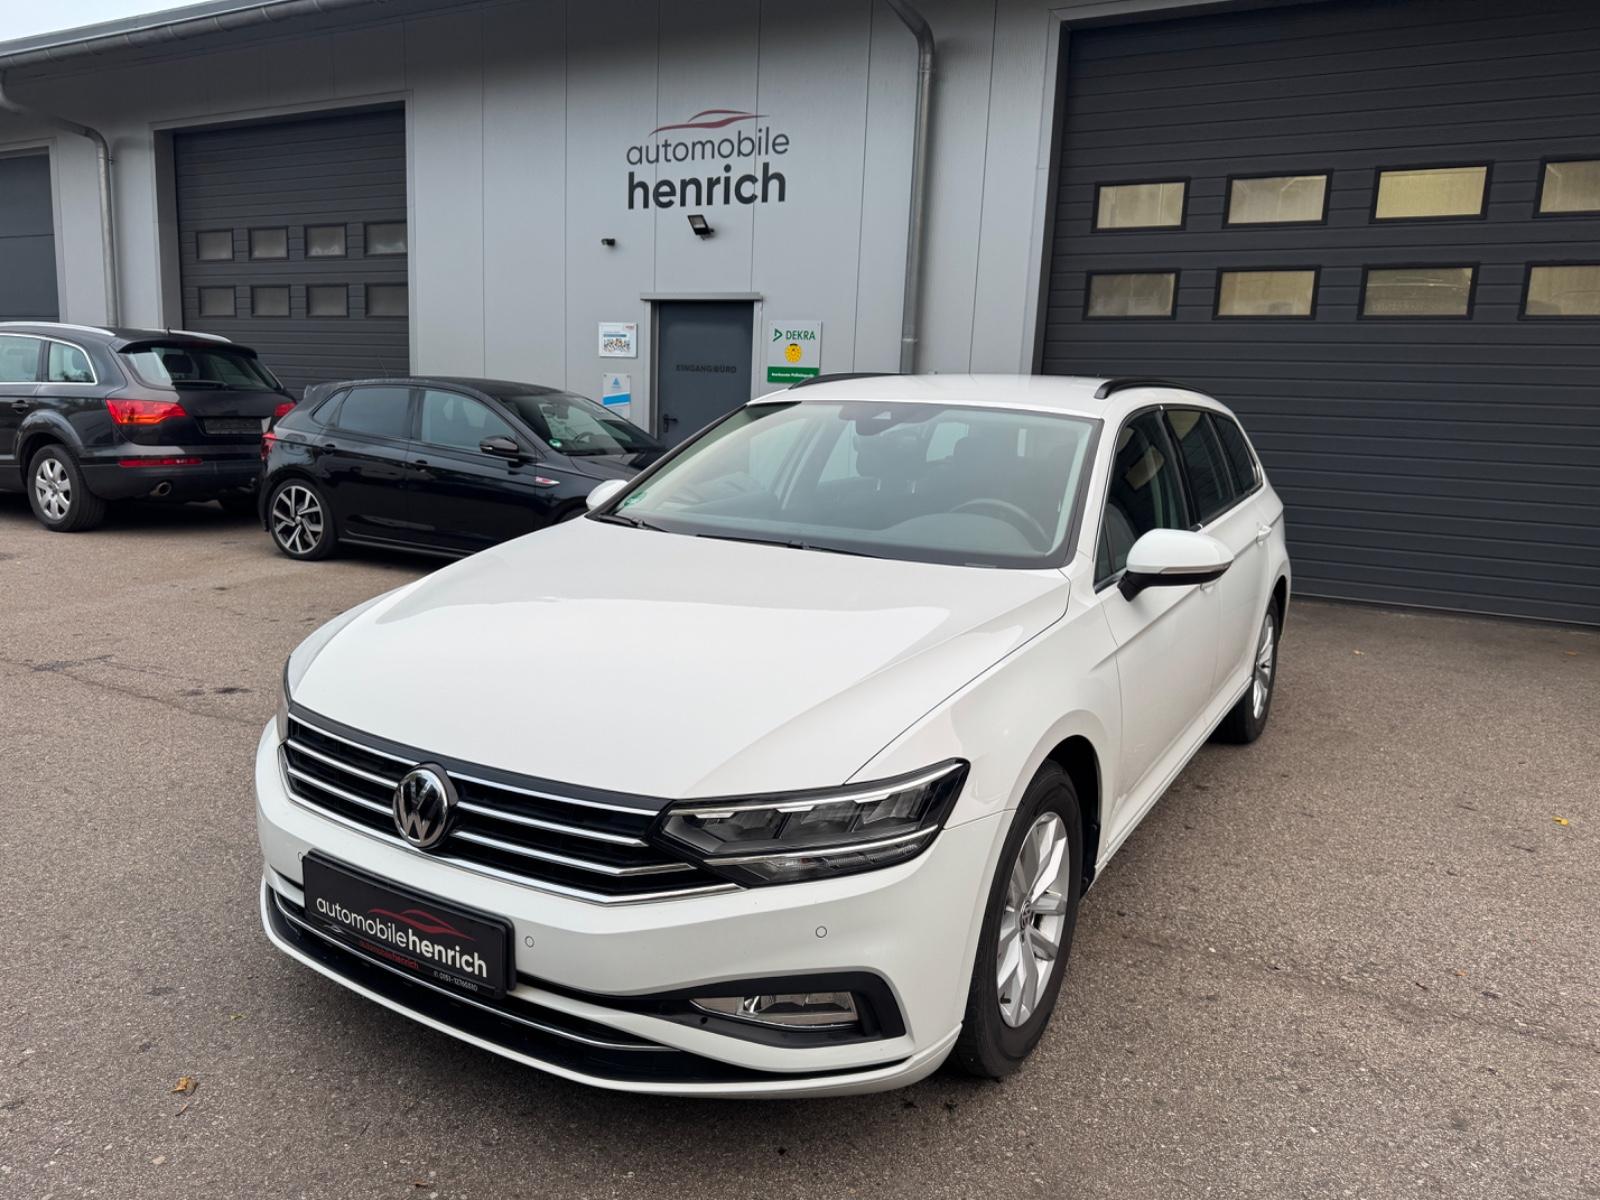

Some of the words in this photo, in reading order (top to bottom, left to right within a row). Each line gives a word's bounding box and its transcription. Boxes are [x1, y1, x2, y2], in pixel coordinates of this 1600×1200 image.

[626, 126, 790, 166] automobile
[627, 161, 787, 210] henrich
[785, 330, 816, 341] DEKRA
